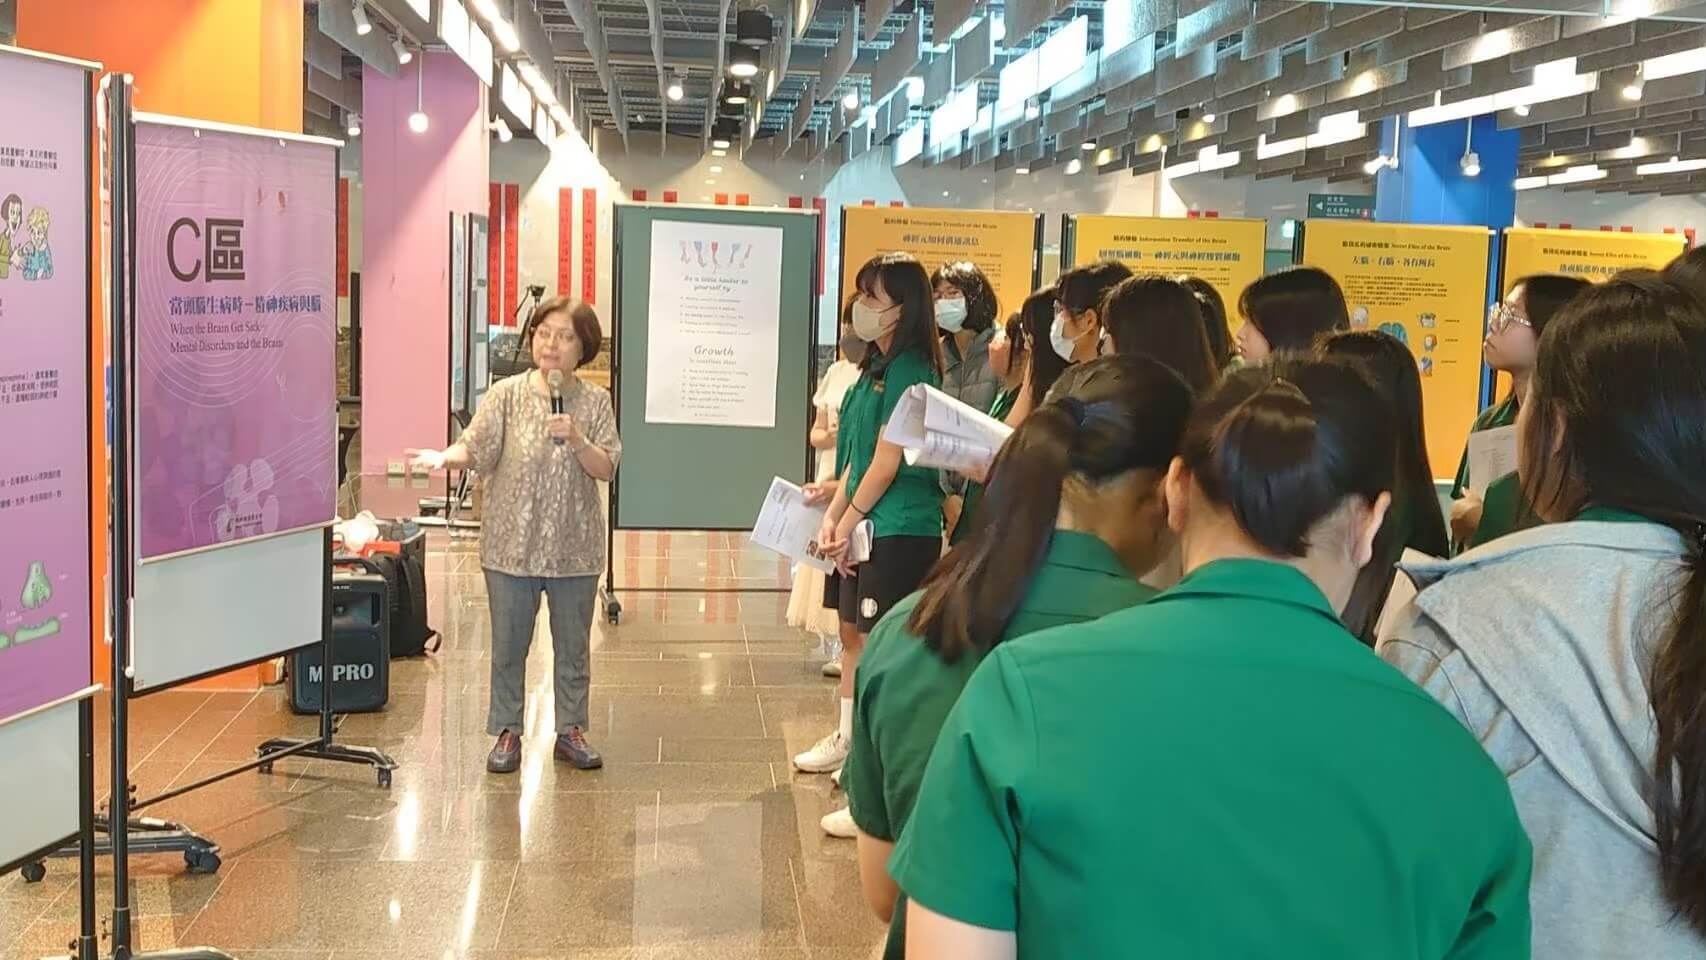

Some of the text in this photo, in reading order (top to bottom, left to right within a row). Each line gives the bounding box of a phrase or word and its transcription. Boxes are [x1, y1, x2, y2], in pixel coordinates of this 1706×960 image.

[167, 217, 245, 283] C區
[170, 323, 194, 335] When
[195, 322, 205, 334] the
[207, 322, 229, 334] Brain
[231, 321, 244, 333] Get
[170, 337, 283, 353] Mental Disorders and the Brain
[694, 345, 734, 356] Growth
[309, 663, 374, 683] MPRO
